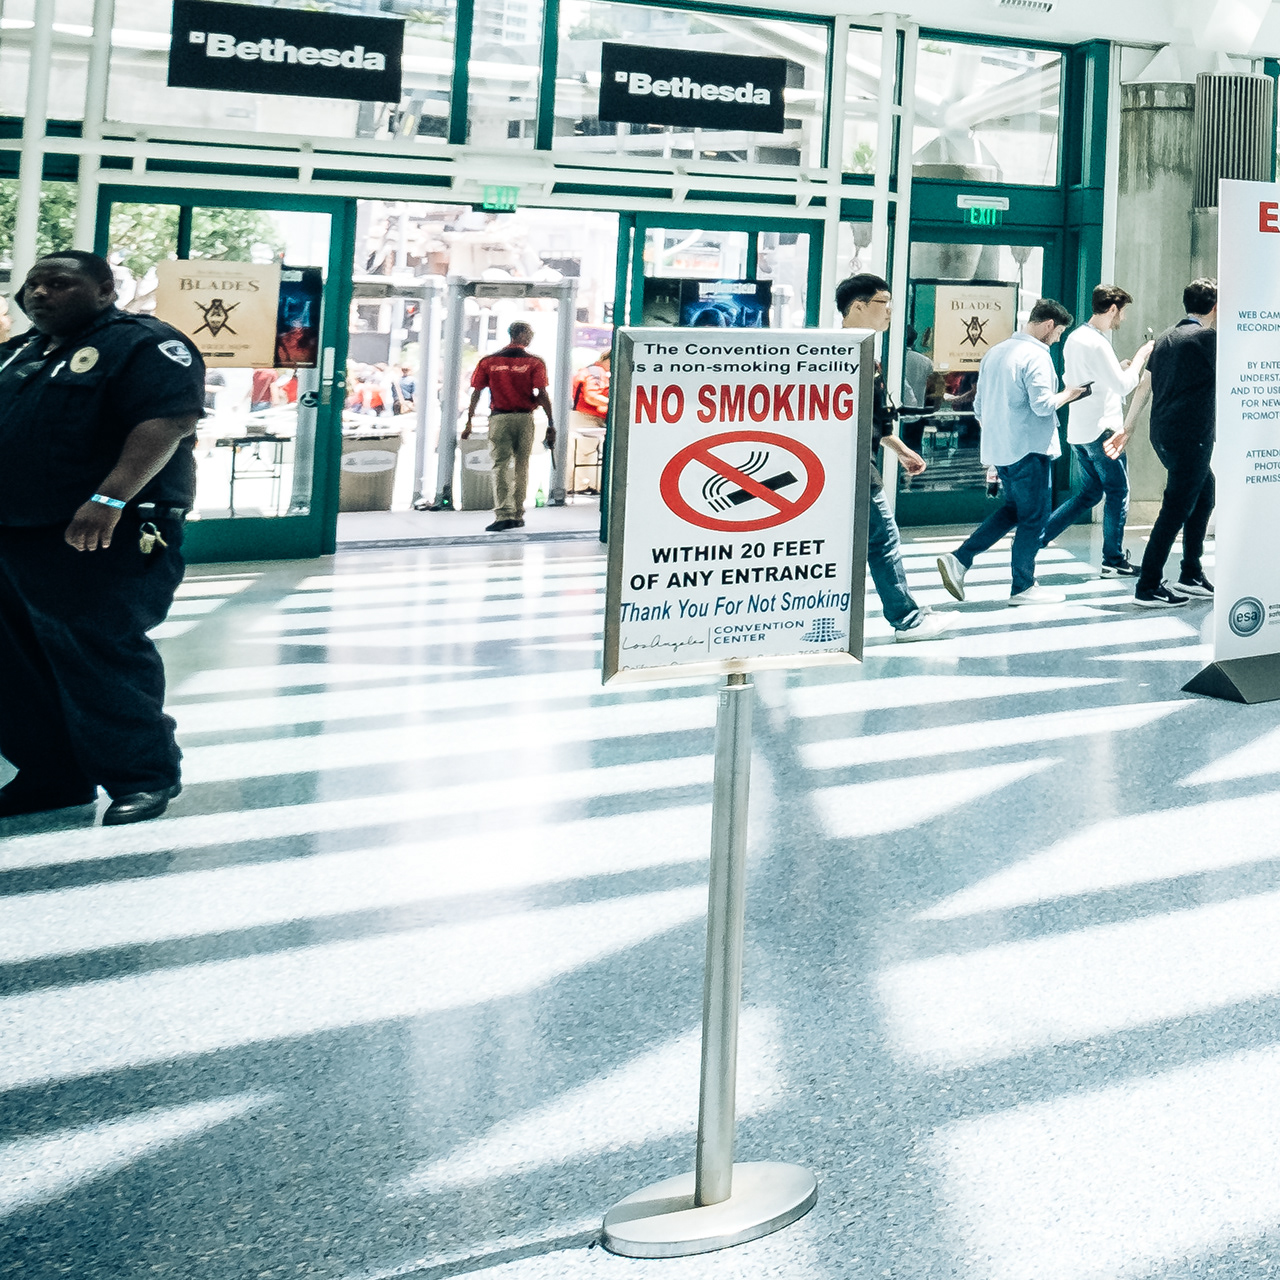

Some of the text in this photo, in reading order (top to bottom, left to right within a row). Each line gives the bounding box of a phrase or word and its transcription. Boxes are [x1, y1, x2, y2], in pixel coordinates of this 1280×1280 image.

[206, 32, 386, 70] Bethesda
[628, 72, 771, 105] Bethesda
[970, 206, 996, 225] EXIT
[179, 277, 260, 293] BLADES
[951, 300, 1002, 311] BLADES
[1238, 311, 1257, 319] WEB
[644, 343, 855, 355] The Convention Center
[632, 361, 859, 374] is a non-smoking Facility
[1247, 361, 1257, 369] BY
[1231, 387, 1251, 395] AND
[635, 383, 853, 424] NO SMOKING
[1241, 399, 1259, 407] FOR
[651, 539, 825, 563] WITHIN 20 FEET
[630, 563, 837, 590] OF ANY ENTRANCE
[620, 589, 850, 622] Thank You For Not Smoking
[1237, 609, 1257, 623] esa
[714, 620, 804, 634] CONVENTION
[713, 633, 766, 644] CENTER
